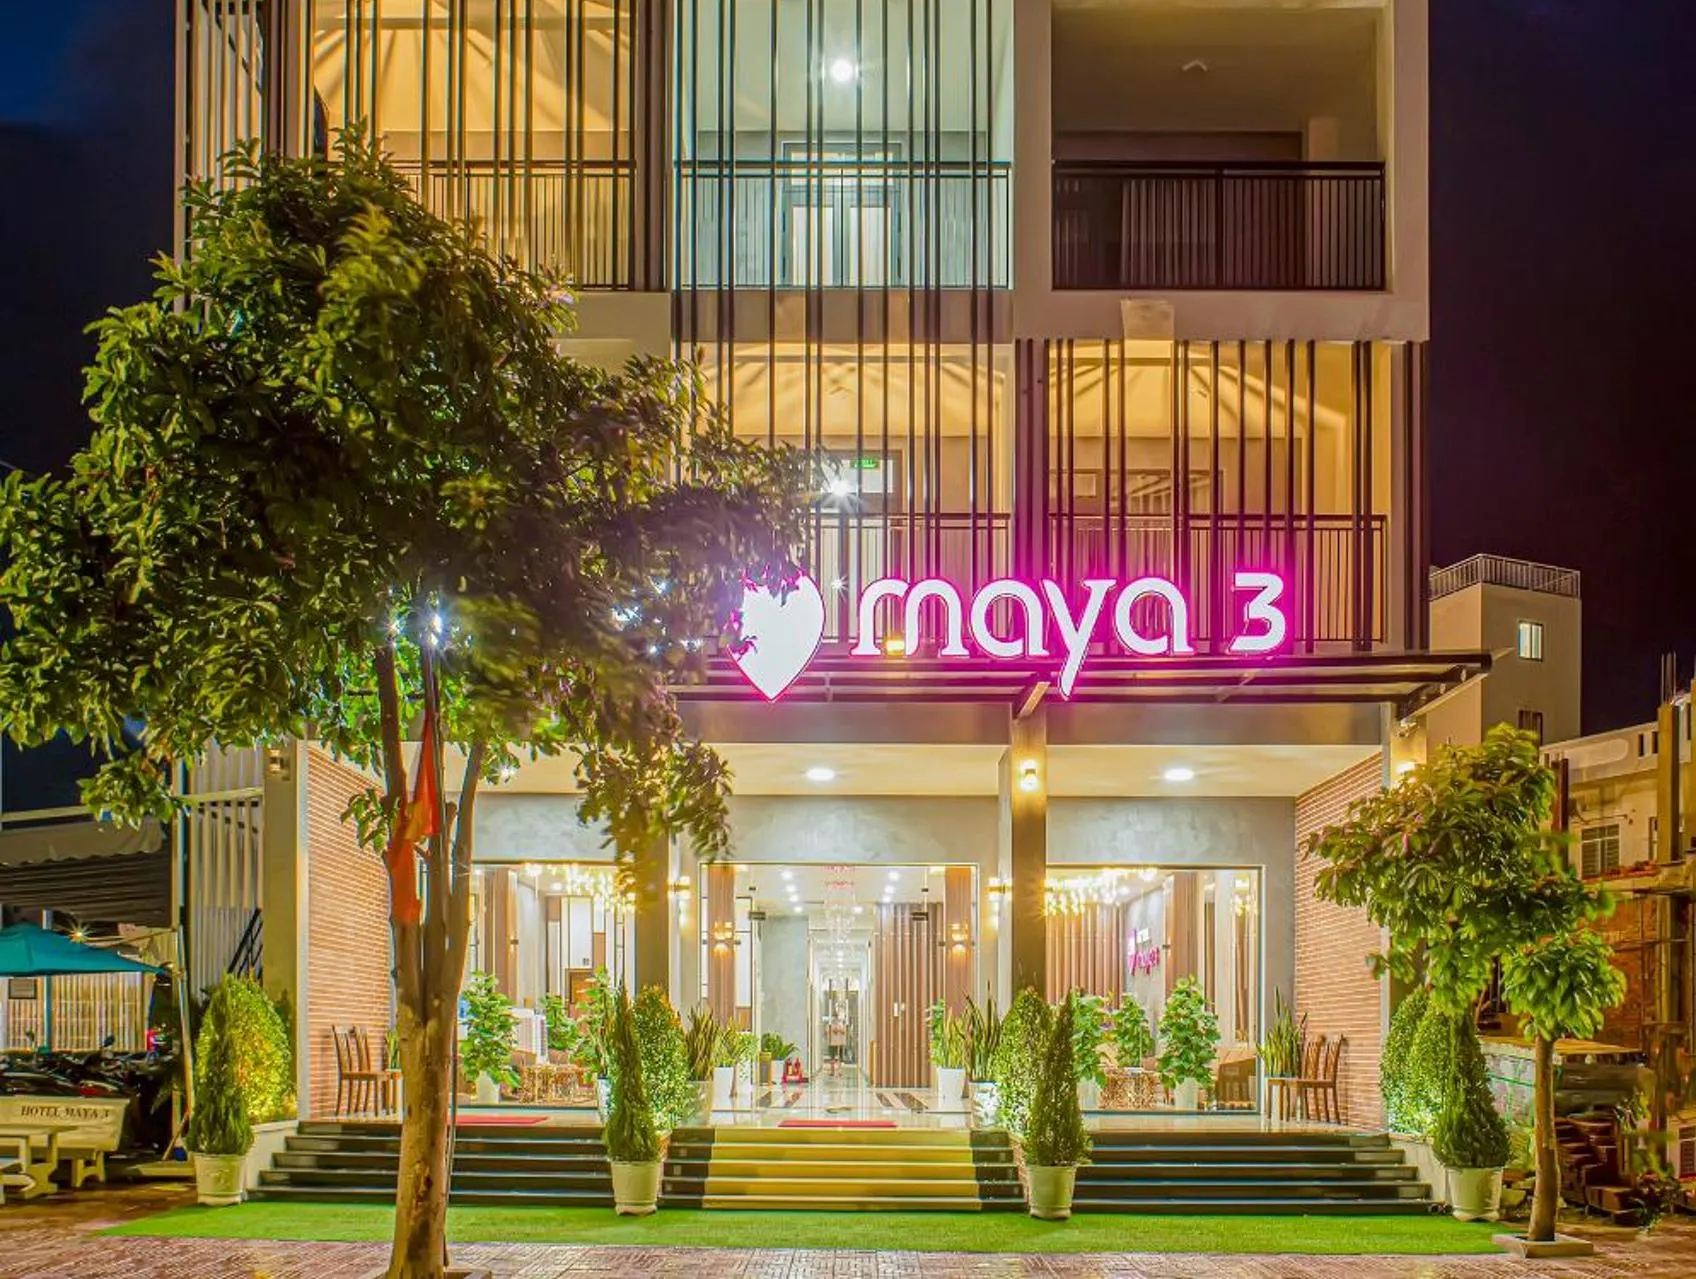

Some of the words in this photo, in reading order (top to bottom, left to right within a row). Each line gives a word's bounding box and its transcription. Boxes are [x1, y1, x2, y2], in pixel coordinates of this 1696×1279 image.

[849, 576, 1195, 700] maya
[1228, 571, 1288, 655] 3
[20, 1105, 60, 1118] HOTEL
